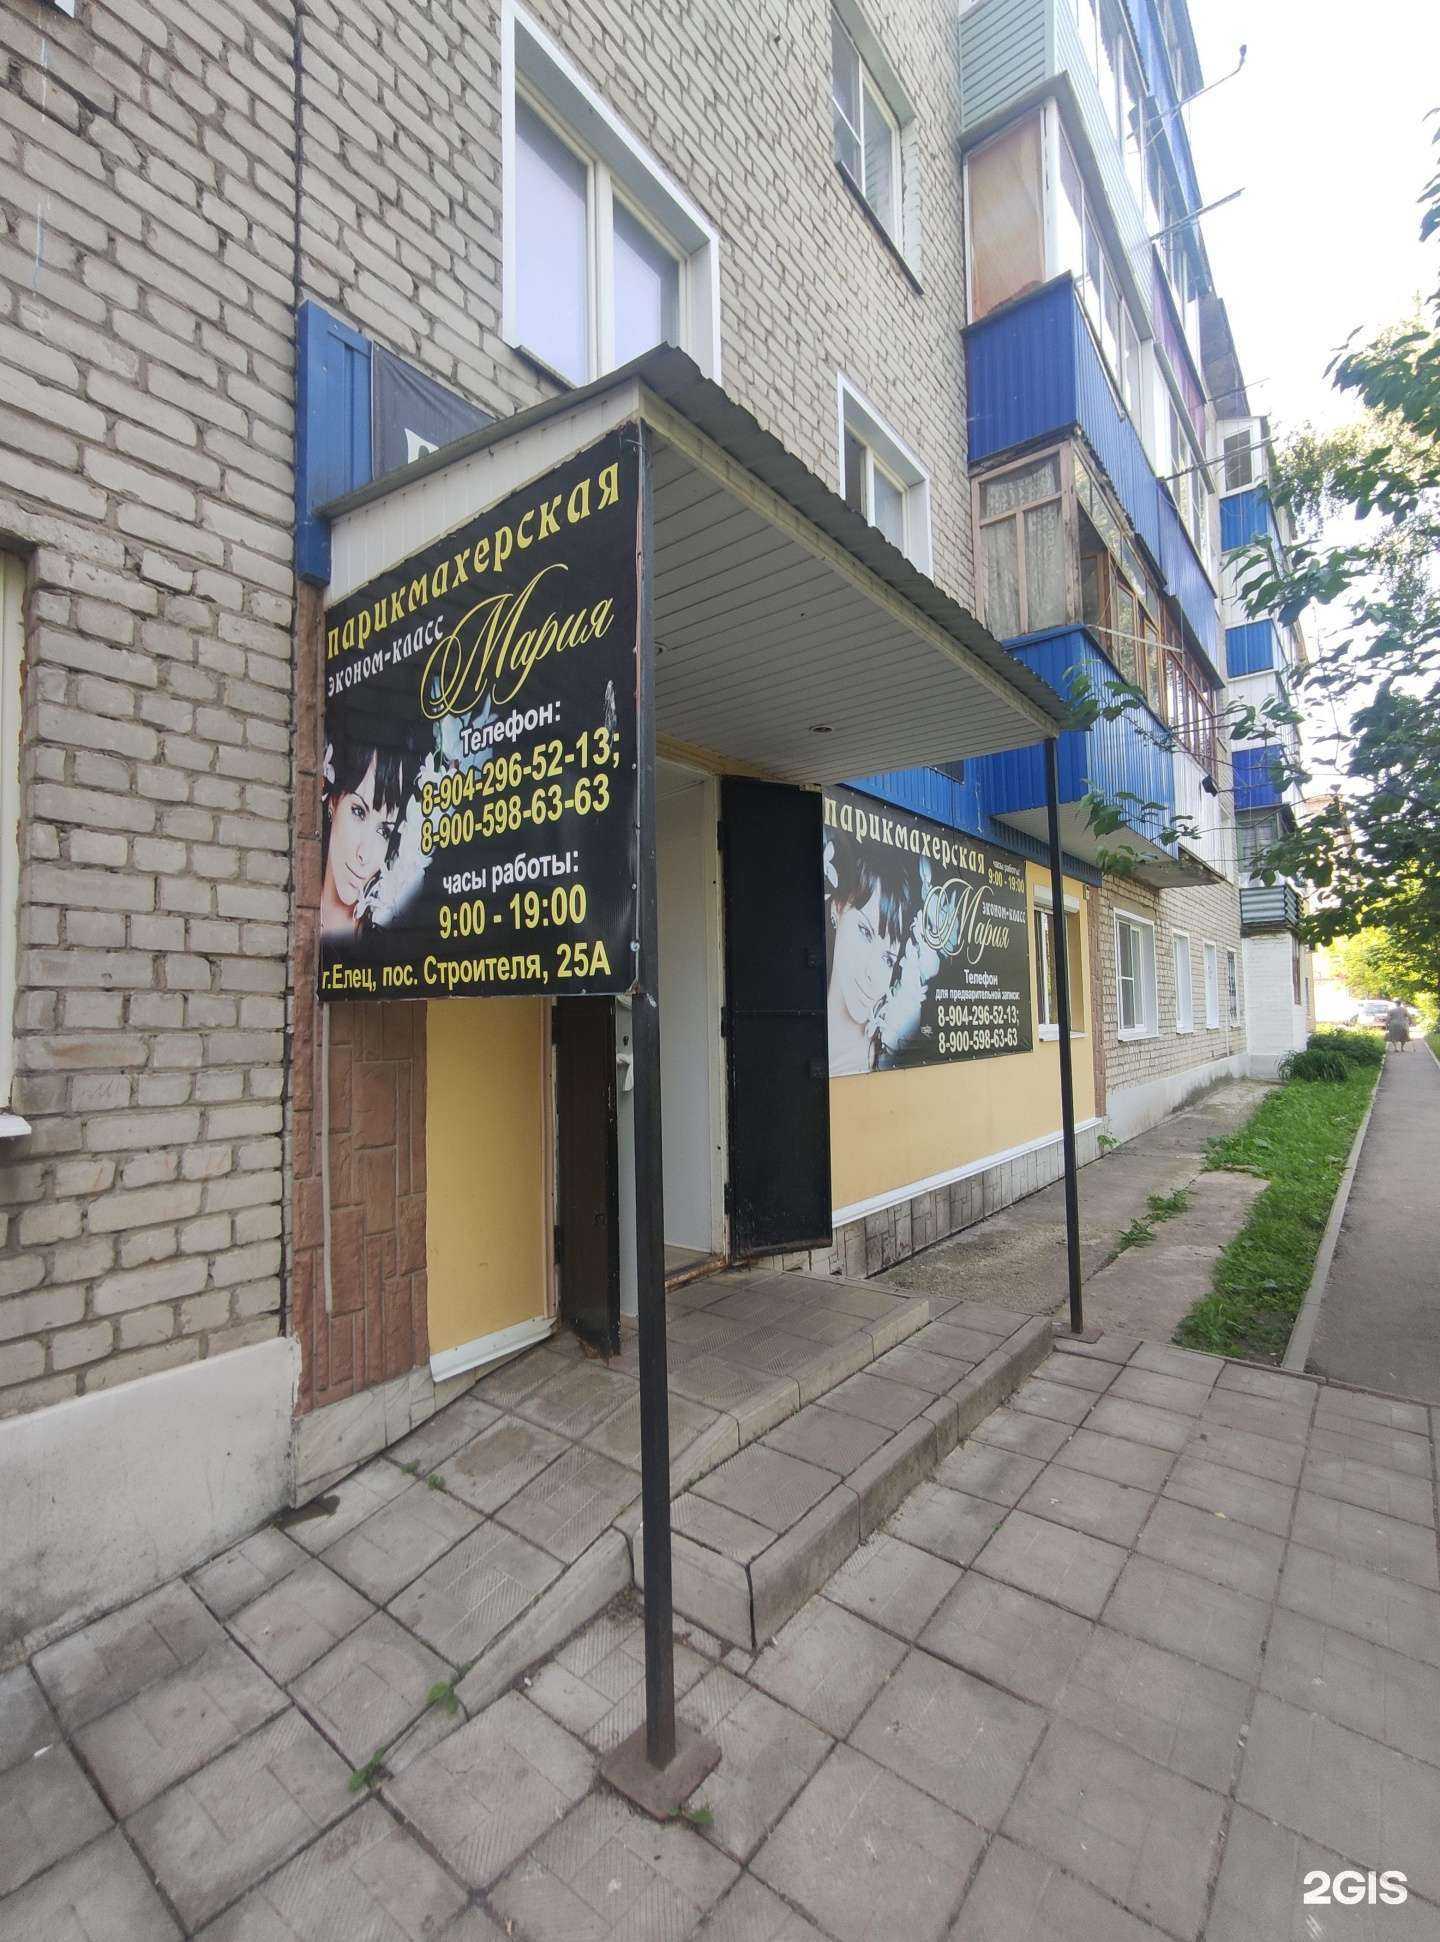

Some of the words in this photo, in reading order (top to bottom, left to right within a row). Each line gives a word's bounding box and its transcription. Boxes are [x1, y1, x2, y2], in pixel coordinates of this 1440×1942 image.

[327, 462, 620, 661] парикмахерская
[327, 614, 445, 698] эконом-класс
[420, 563, 615, 720] Мария
[460, 700, 562, 756] Телефон:
[421, 726, 621, 816] 8-904-296-52-13;
[420, 773, 611, 853] 8-900-598-63-63
[824, 797, 985, 876] парикмахерская
[443, 866, 487, 895] часы
[491, 850, 580, 892] работы:
[988, 868, 1003, 887] 9:00
[1008, 875, 1025, 894] 19:00
[439, 900, 486, 939] 9:00
[509, 884, 587, 930] 19:00
[921, 877, 1010, 965] Мария
[322, 963, 377, 993] г.Елец,
[382, 957, 418, 988] пос.
[423, 952, 549, 991] Строителя,
[963, 968, 999, 989] Телефон
[938, 1005, 1020, 1027] 8-904-296-52-13;
[938, 1027, 1018, 1054] 8-900-598-63-63
